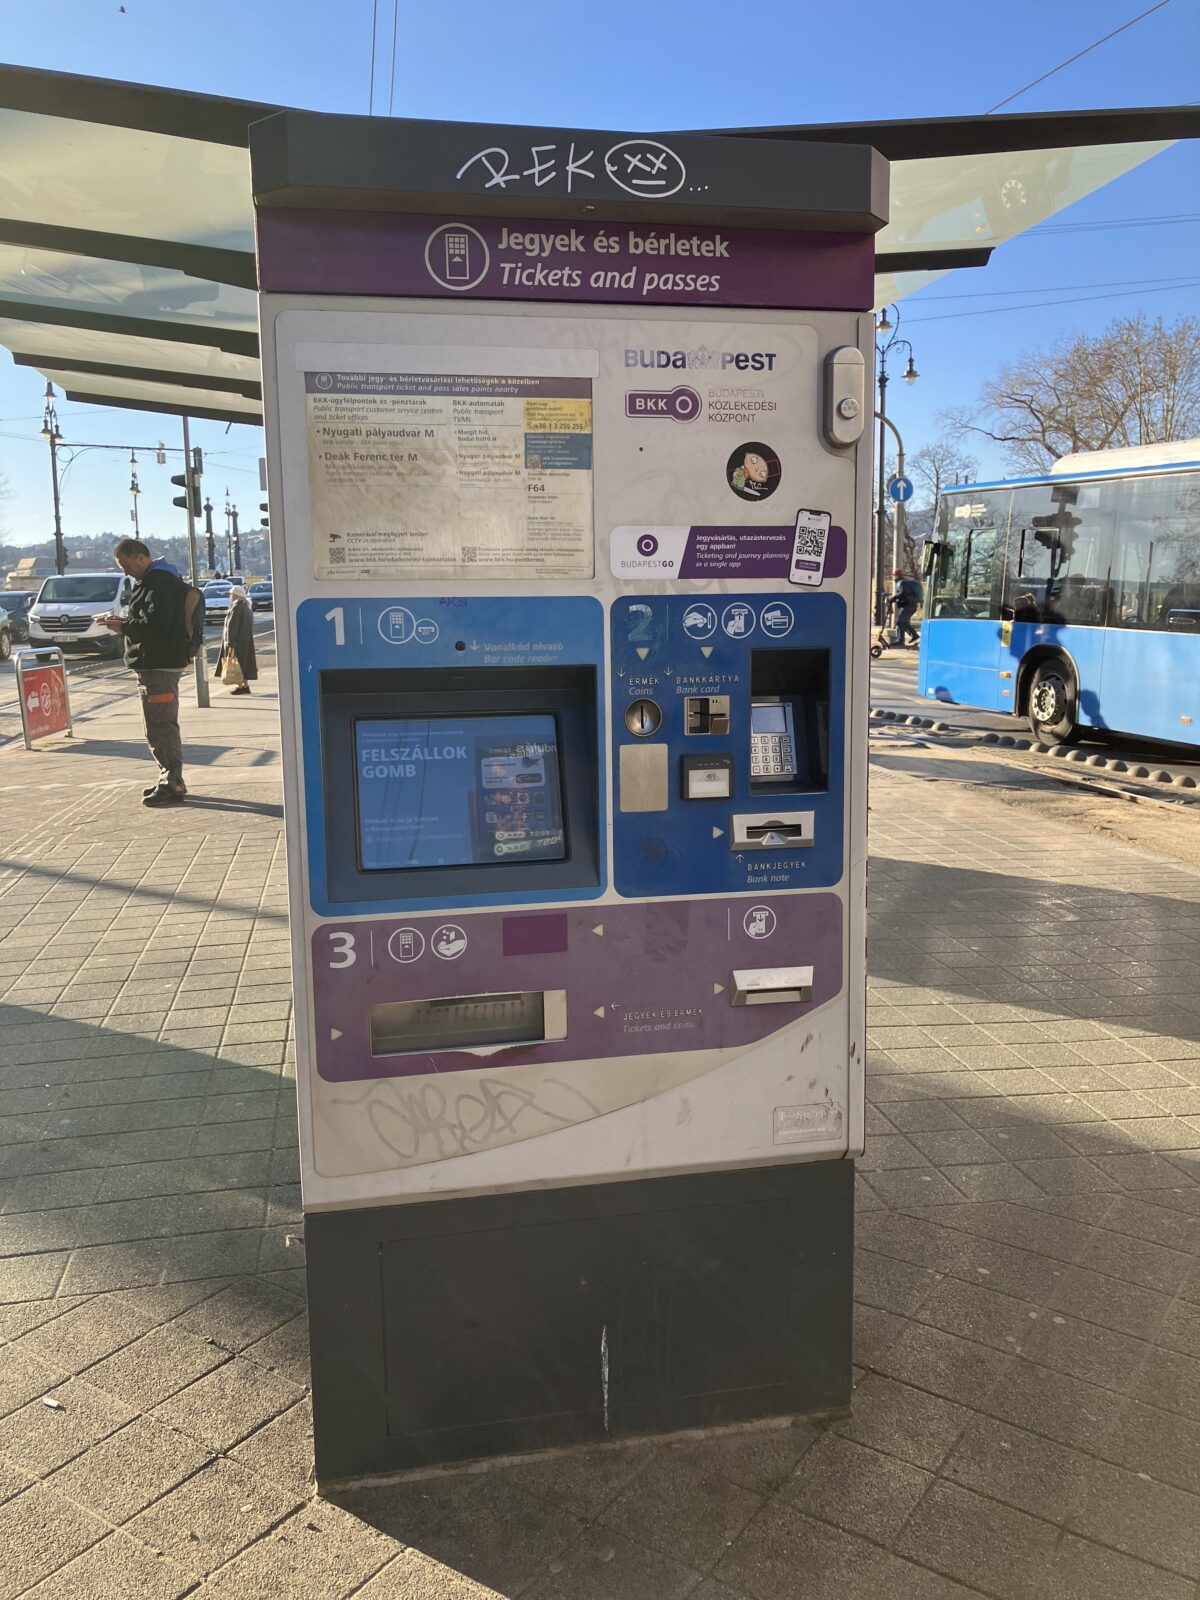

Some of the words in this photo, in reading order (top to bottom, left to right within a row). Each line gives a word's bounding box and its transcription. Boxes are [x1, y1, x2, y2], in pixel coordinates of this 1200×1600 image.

[498, 227, 586, 258] Jegyek
[593, 230, 620, 254] és
[628, 230, 730, 258] bérletek
[500, 263, 582, 287] Tickets
[590, 266, 637, 289] and
[642, 271, 721, 295] passes
[337, 382, 359, 390] Public
[495, 386, 519, 394] nearby
[708, 388, 765, 399] BUDAPESTI
[636, 398, 668, 411] BKK
[708, 411, 756, 423] KÖZPONT
[322, 427, 362, 438] Nyugati
[365, 428, 421, 439] pályaudvar
[424, 429, 435, 438] M
[324, 452, 350, 461] Deák
[353, 452, 386, 461] Ferenc
[407, 453, 418, 462] M
[527, 484, 545, 493] F64
[695, 534, 738, 543] Jegyvásárlás,
[739, 534, 787, 542] utazástervezés
[695, 543, 707, 551] egy
[709, 543, 736, 551] appban!
[696, 552, 723, 560] Ticketing
[738, 553, 761, 561] journey
[762, 553, 790, 561] planning
[621, 560, 674, 568] BUDAPESTGO
[708, 561, 729, 569] single
[324, 607, 345, 646] 1
[627, 604, 653, 642] 2
[484, 641, 530, 652] Vonalkód
[532, 642, 564, 651] olvasó
[484, 655, 500, 664] Bar
[502, 655, 525, 663] code
[528, 655, 559, 663] reader
[629, 674, 660, 686] ÉRMÉK
[675, 673, 740, 685] BANKKÁRTYA
[628, 687, 654, 695] Coins
[675, 685, 698, 694] Bank
[700, 685, 720, 694] card
[361, 743, 468, 762] FELSZÁLLOK
[362, 765, 417, 779] GOMB
[747, 861, 807, 872] BANKJEGYEK
[747, 874, 768, 884] Bank
[770, 873, 790, 883] note
[329, 932, 357, 969] 3
[623, 1011, 657, 1021] JEGYEK
[623, 1023, 652, 1033] Tickets
[654, 1022, 671, 1031] and
